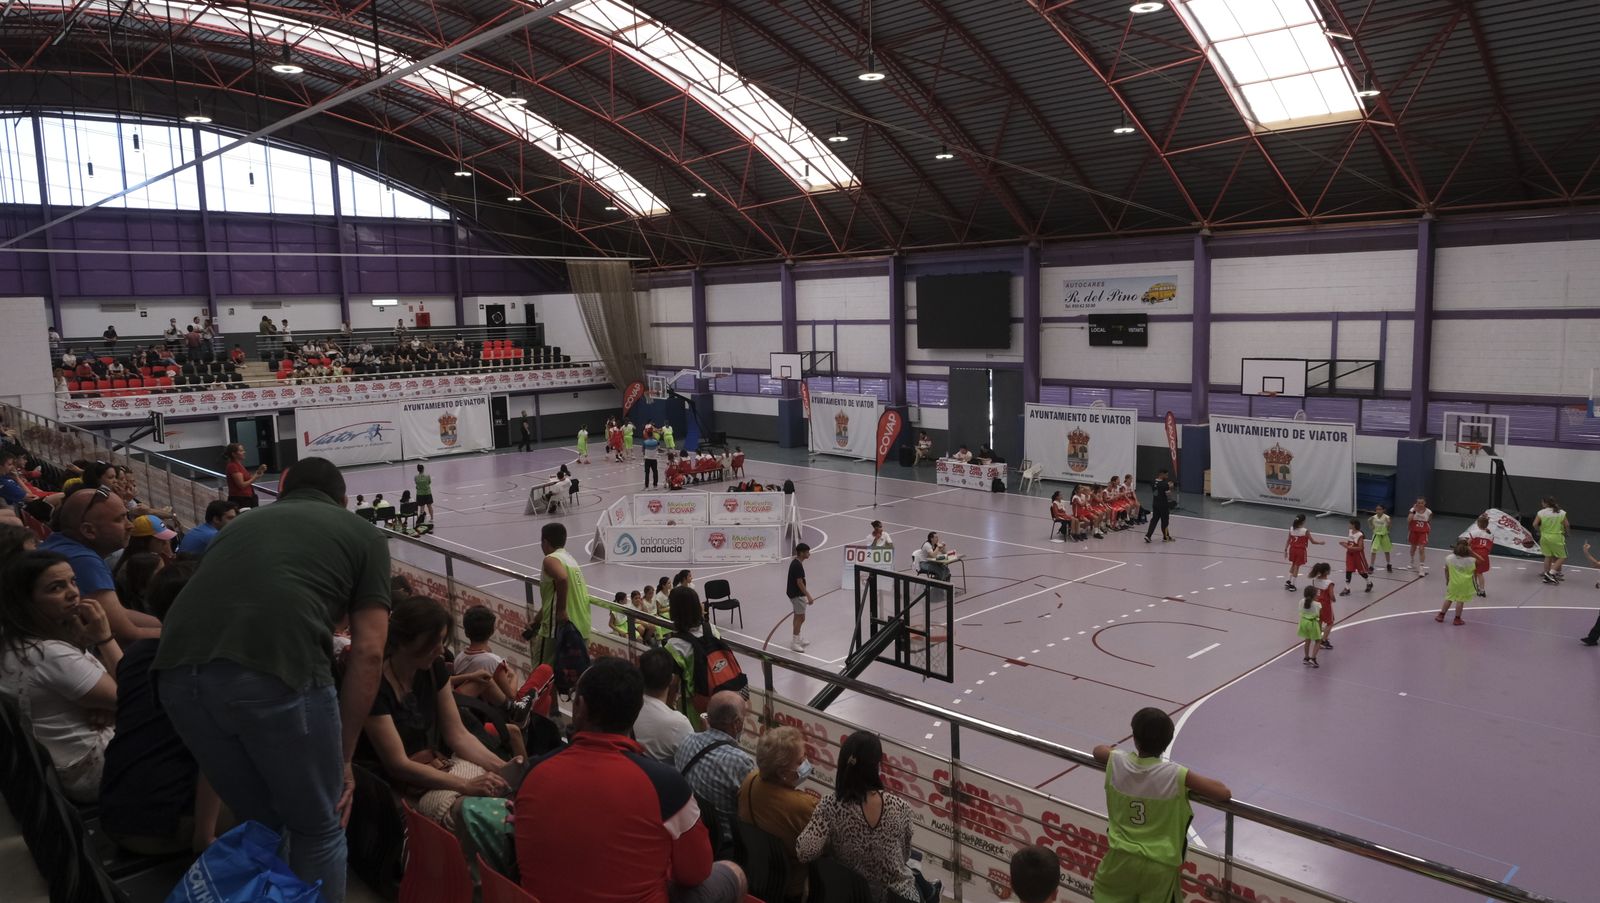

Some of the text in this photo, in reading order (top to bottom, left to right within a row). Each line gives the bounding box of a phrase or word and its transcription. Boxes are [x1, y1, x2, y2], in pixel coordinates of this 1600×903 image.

[1064, 289, 1138, 302] R. del Pino
[624, 384, 641, 409] COVAP
[811, 397, 847, 407] AYUNTAMIENTO
[856, 400, 874, 408] VIATOR
[403, 402, 453, 412] AYUNTAMIENTO
[464, 398, 486, 406] VIATOR
[1030, 409, 1131, 424] AYUNTAMIENTO DE VIATOR
[880, 413, 896, 455] COVAP
[1216, 423, 1347, 442] AYUNTAMIENTO DE VIATOR
[640, 536, 684, 545] baloncesto
[1130, 801, 1146, 825] 3
